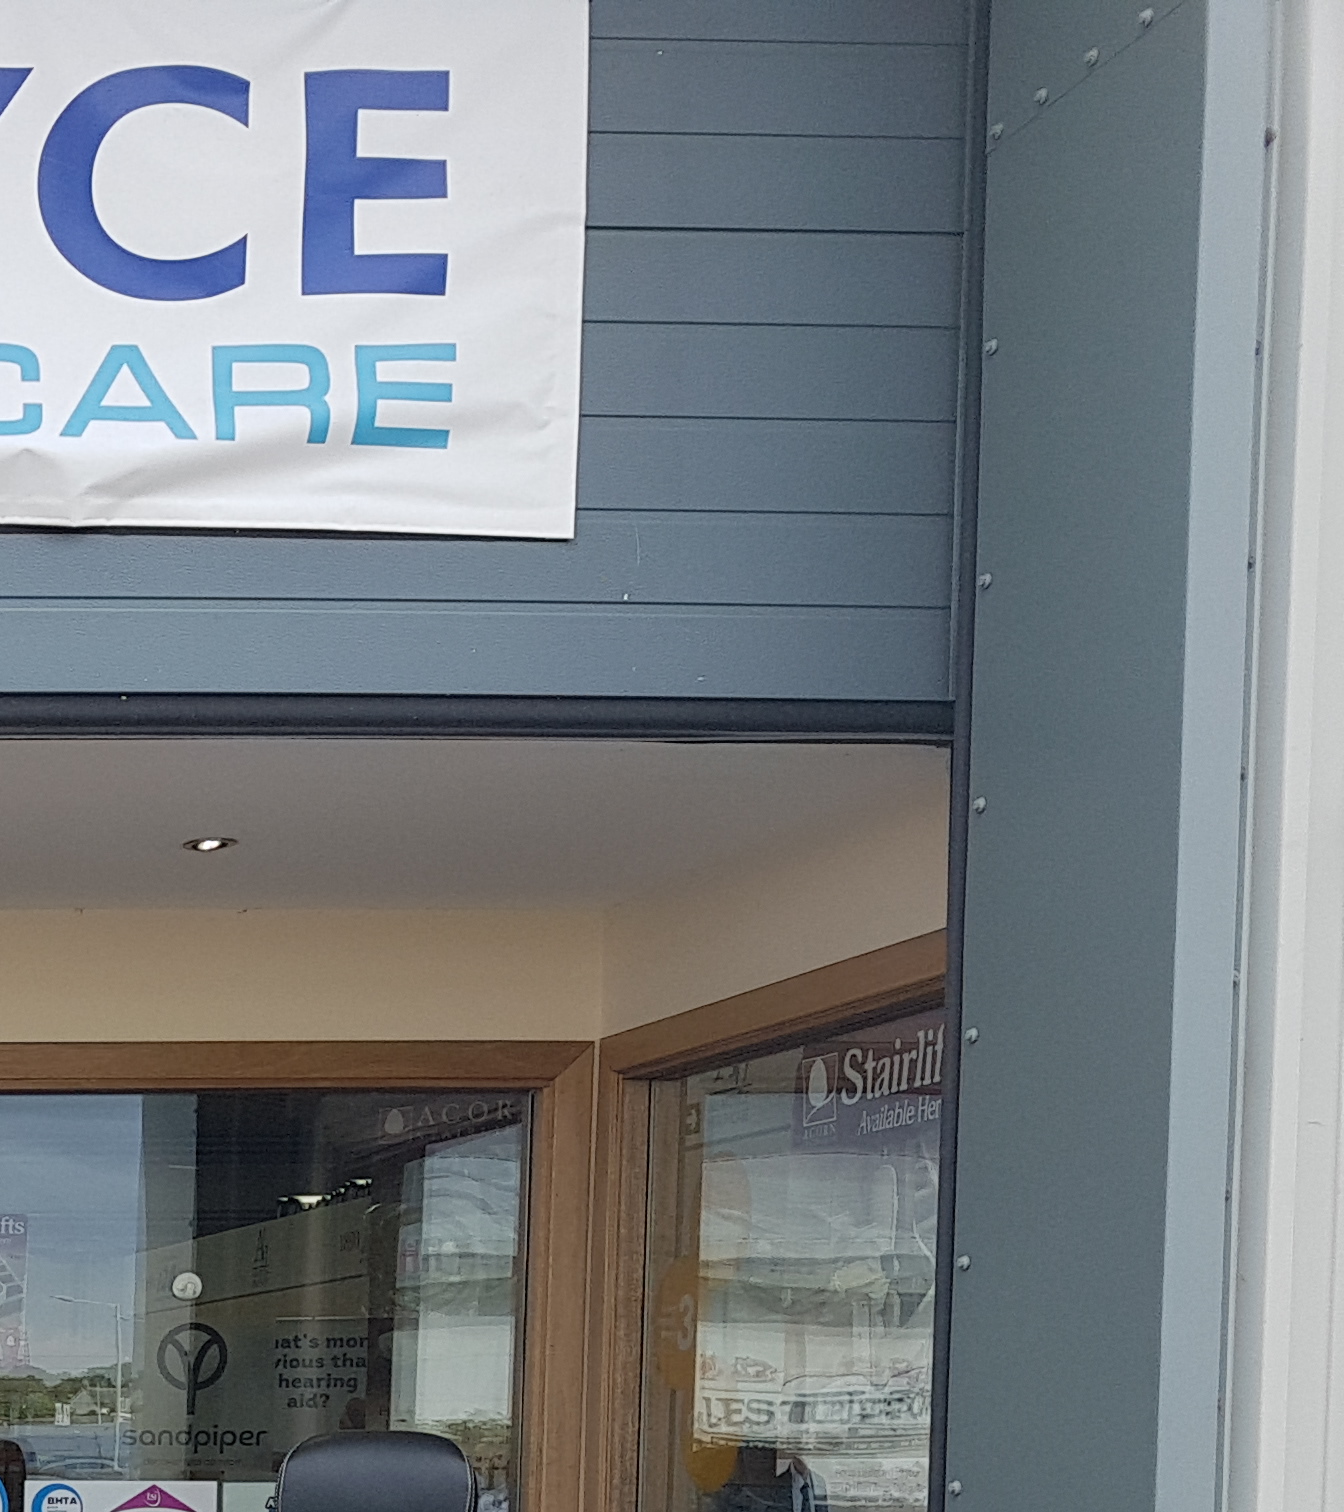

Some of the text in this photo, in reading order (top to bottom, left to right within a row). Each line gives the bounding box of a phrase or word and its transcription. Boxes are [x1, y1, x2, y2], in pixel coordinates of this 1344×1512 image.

[278, 1373, 358, 1393] hearing
[286, 1393, 330, 1409] aid?
[122, 1424, 268, 1453] sandpiper
[47, 1496, 78, 1505] BHTA
